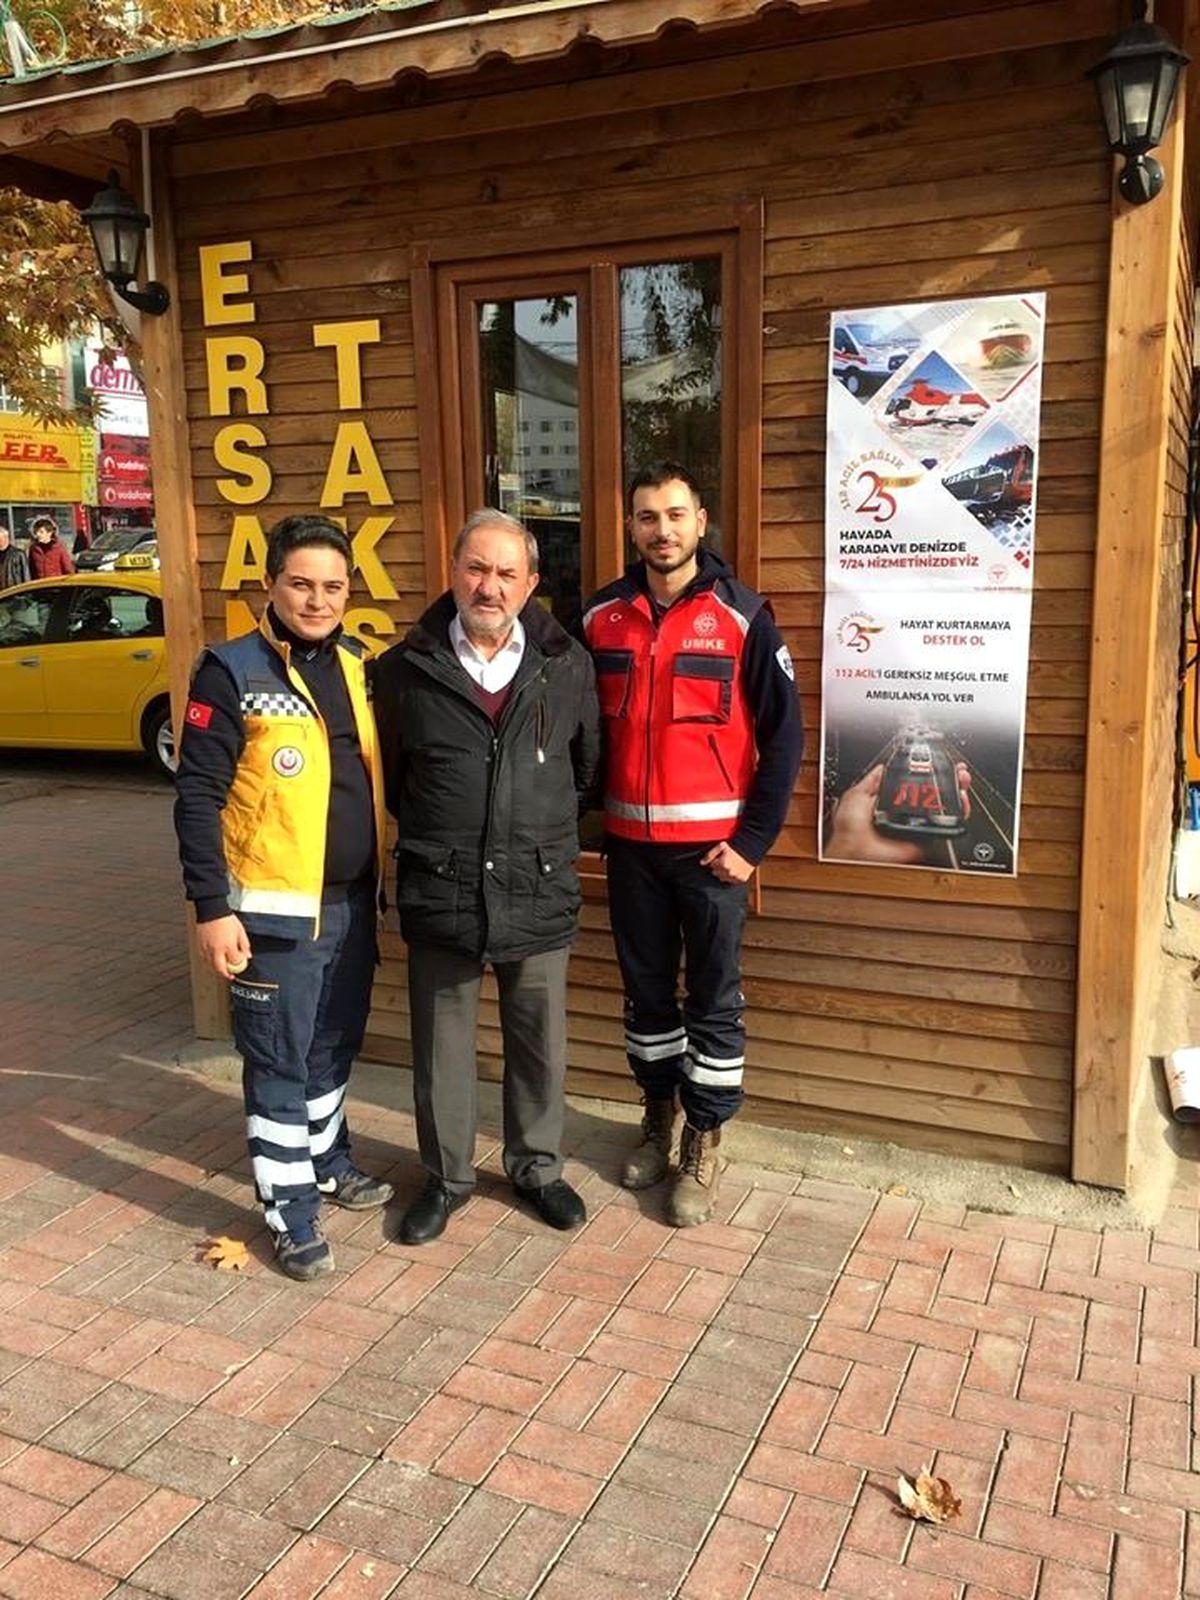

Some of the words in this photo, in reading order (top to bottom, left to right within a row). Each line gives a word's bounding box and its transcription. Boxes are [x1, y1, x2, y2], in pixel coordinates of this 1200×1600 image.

[0, 442, 59, 461] EER
[855, 470, 897, 522] 25
[840, 529, 892, 540] HAVADA
[839, 544, 888, 554] KARADA
[889, 543, 907, 554] VE
[909, 540, 966, 553] DENİZDE
[840, 558, 865, 569] 7/24
[867, 554, 979, 568] HİZMETİNİZDEYİZ
[900, 620, 934, 630] HAYAT
[936, 620, 1011, 631] KURTARMAYA
[682, 639, 725, 650] UMKE
[923, 634, 967, 645] DESTEK
[969, 635, 986, 646] OL
[835, 668, 853, 678] 112
[883, 669, 932, 680] GEREKSİZ
[934, 671, 977, 683] MEŞGUL
[980, 672, 1009, 683] ETME
[866, 690, 930, 701] AMBULANSA
[931, 692, 951, 702] YOL
[953, 693, 974, 703] VER
